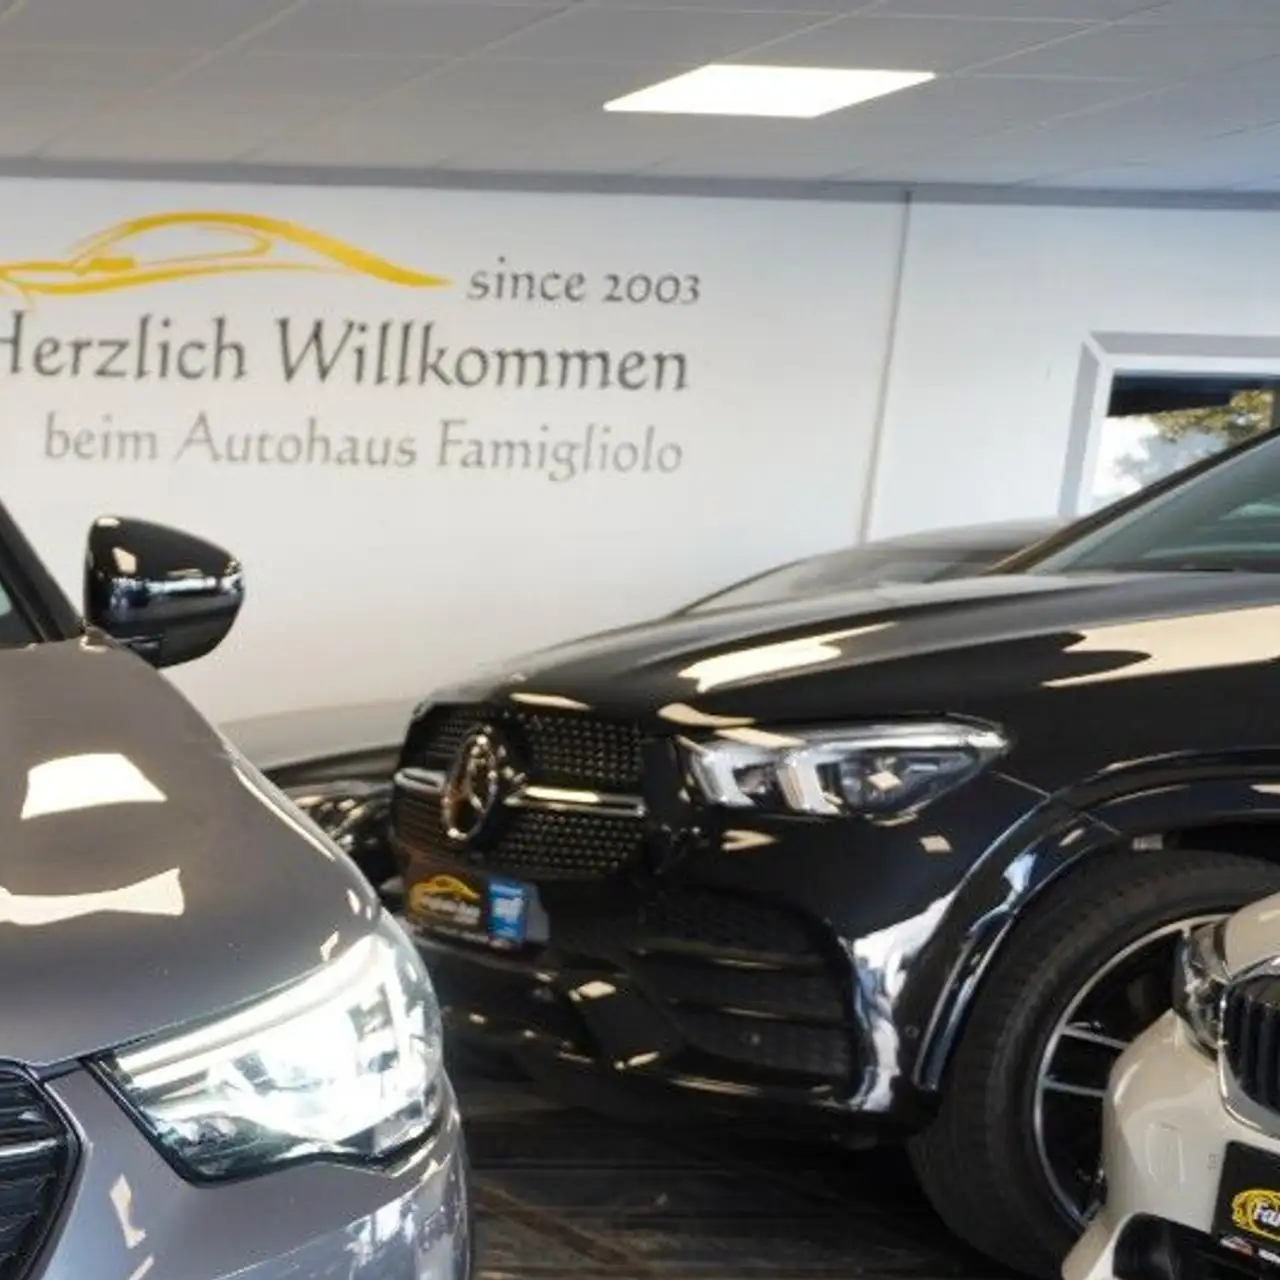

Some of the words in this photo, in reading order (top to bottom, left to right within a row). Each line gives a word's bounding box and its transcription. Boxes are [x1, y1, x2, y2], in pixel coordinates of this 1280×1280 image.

[466, 256, 586, 302] since
[601, 271, 701, 305] 2003
[275, 315, 689, 391] Willkommen
[43, 409, 158, 461] beim
[173, 409, 418, 468] Autohaus
[437, 417, 684, 483] Famigliolo
